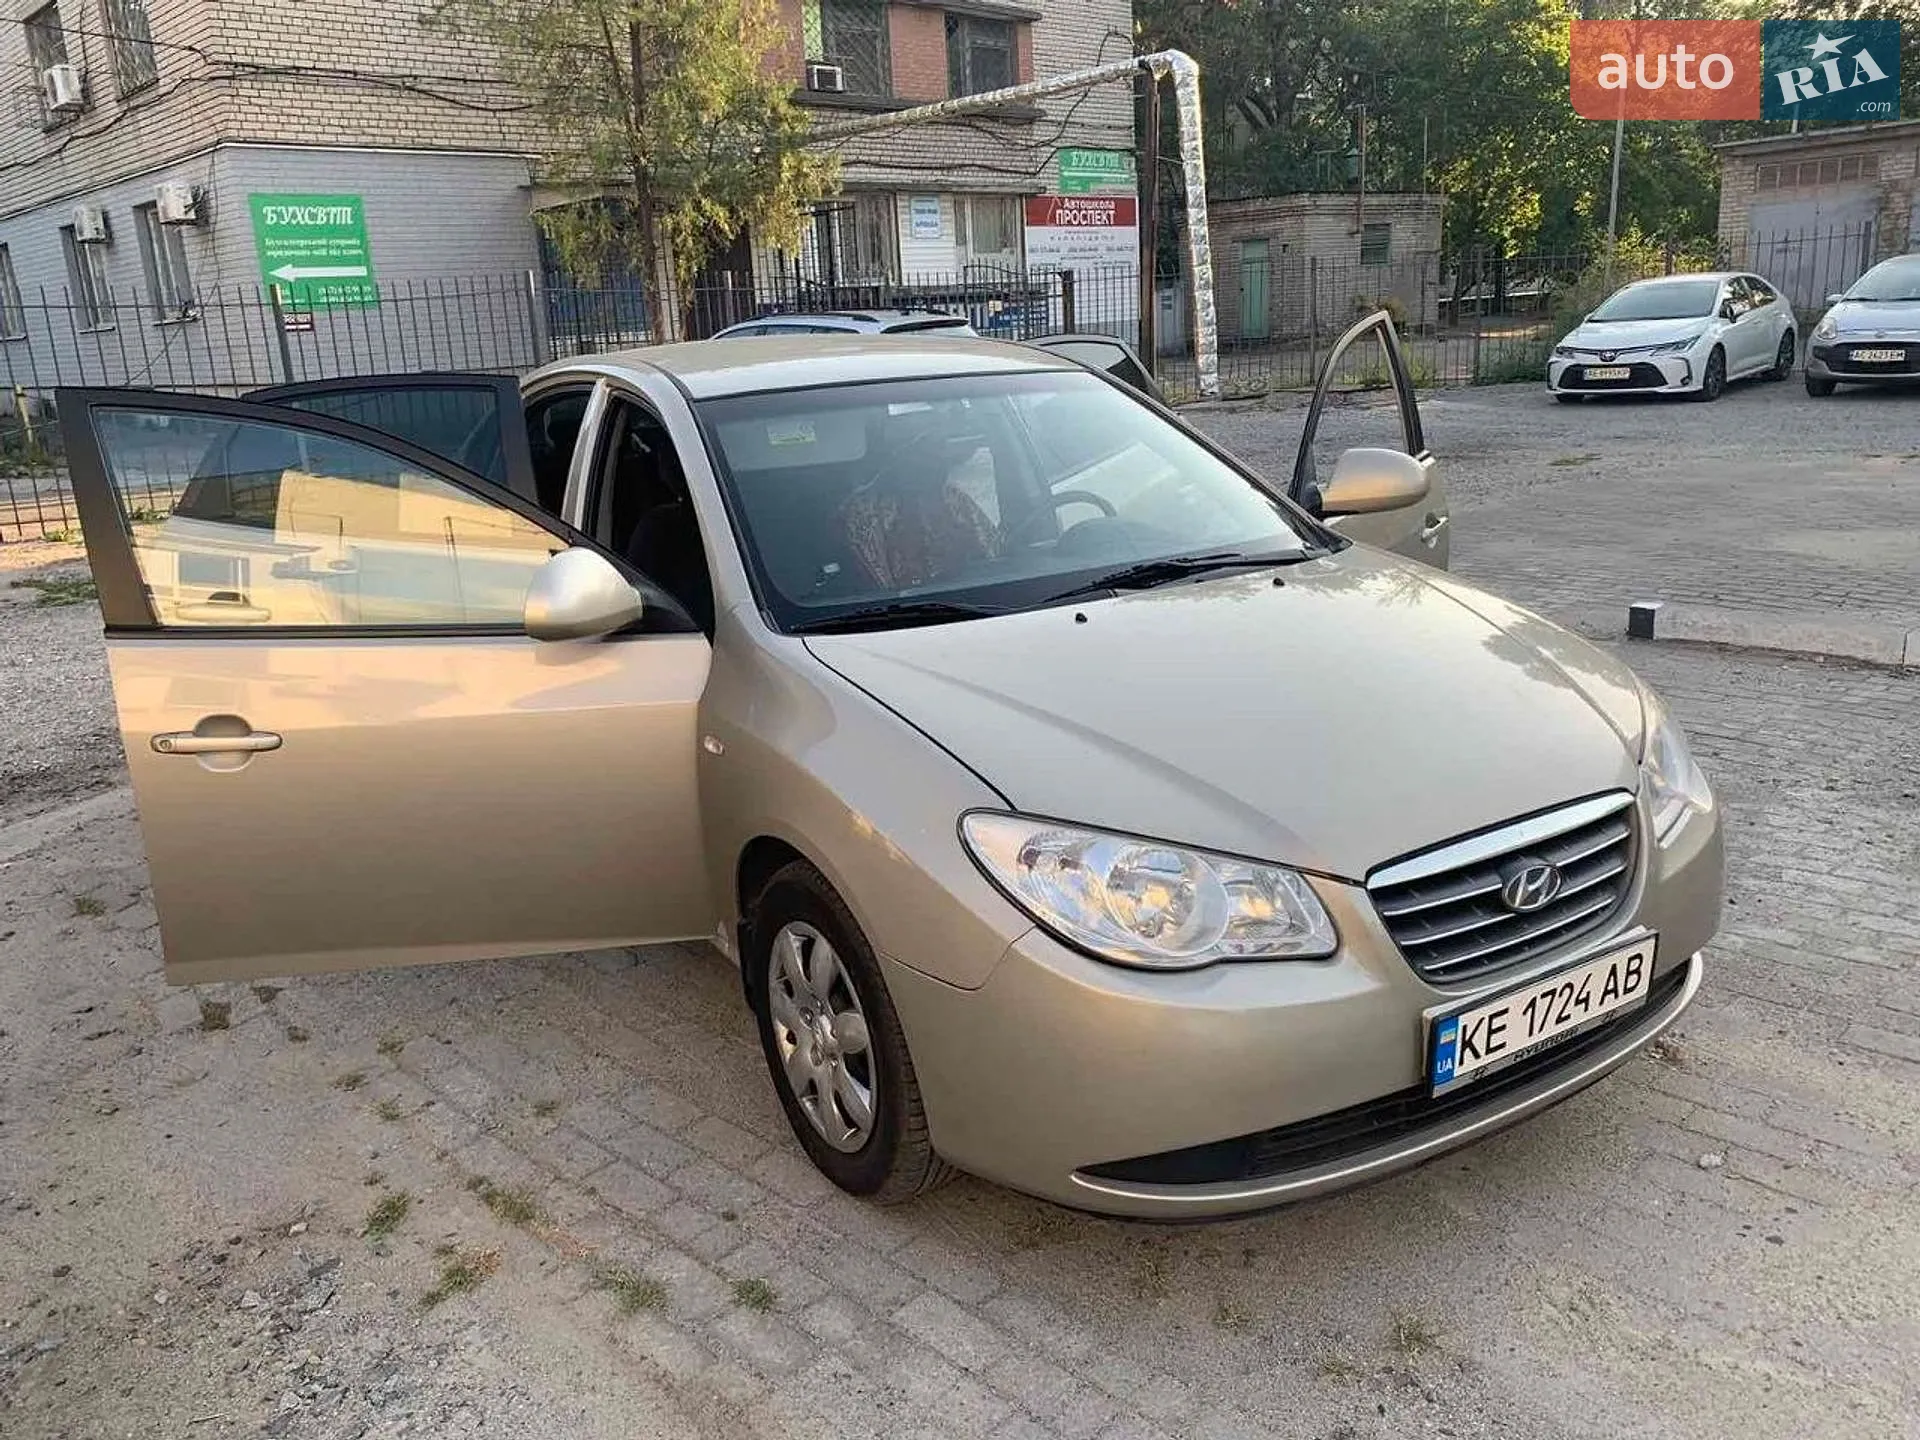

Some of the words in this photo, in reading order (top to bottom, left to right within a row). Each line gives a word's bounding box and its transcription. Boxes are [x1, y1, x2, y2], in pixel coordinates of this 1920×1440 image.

[1063, 198, 1116, 209] Автошкола
[1055, 209, 1116, 225] ПРОСПЕКТ
[1458, 1008, 1510, 1067] KE
[1522, 973, 1593, 1038] 1724
[1598, 953, 1643, 1006] AB
[1437, 1061, 1453, 1074] UA
